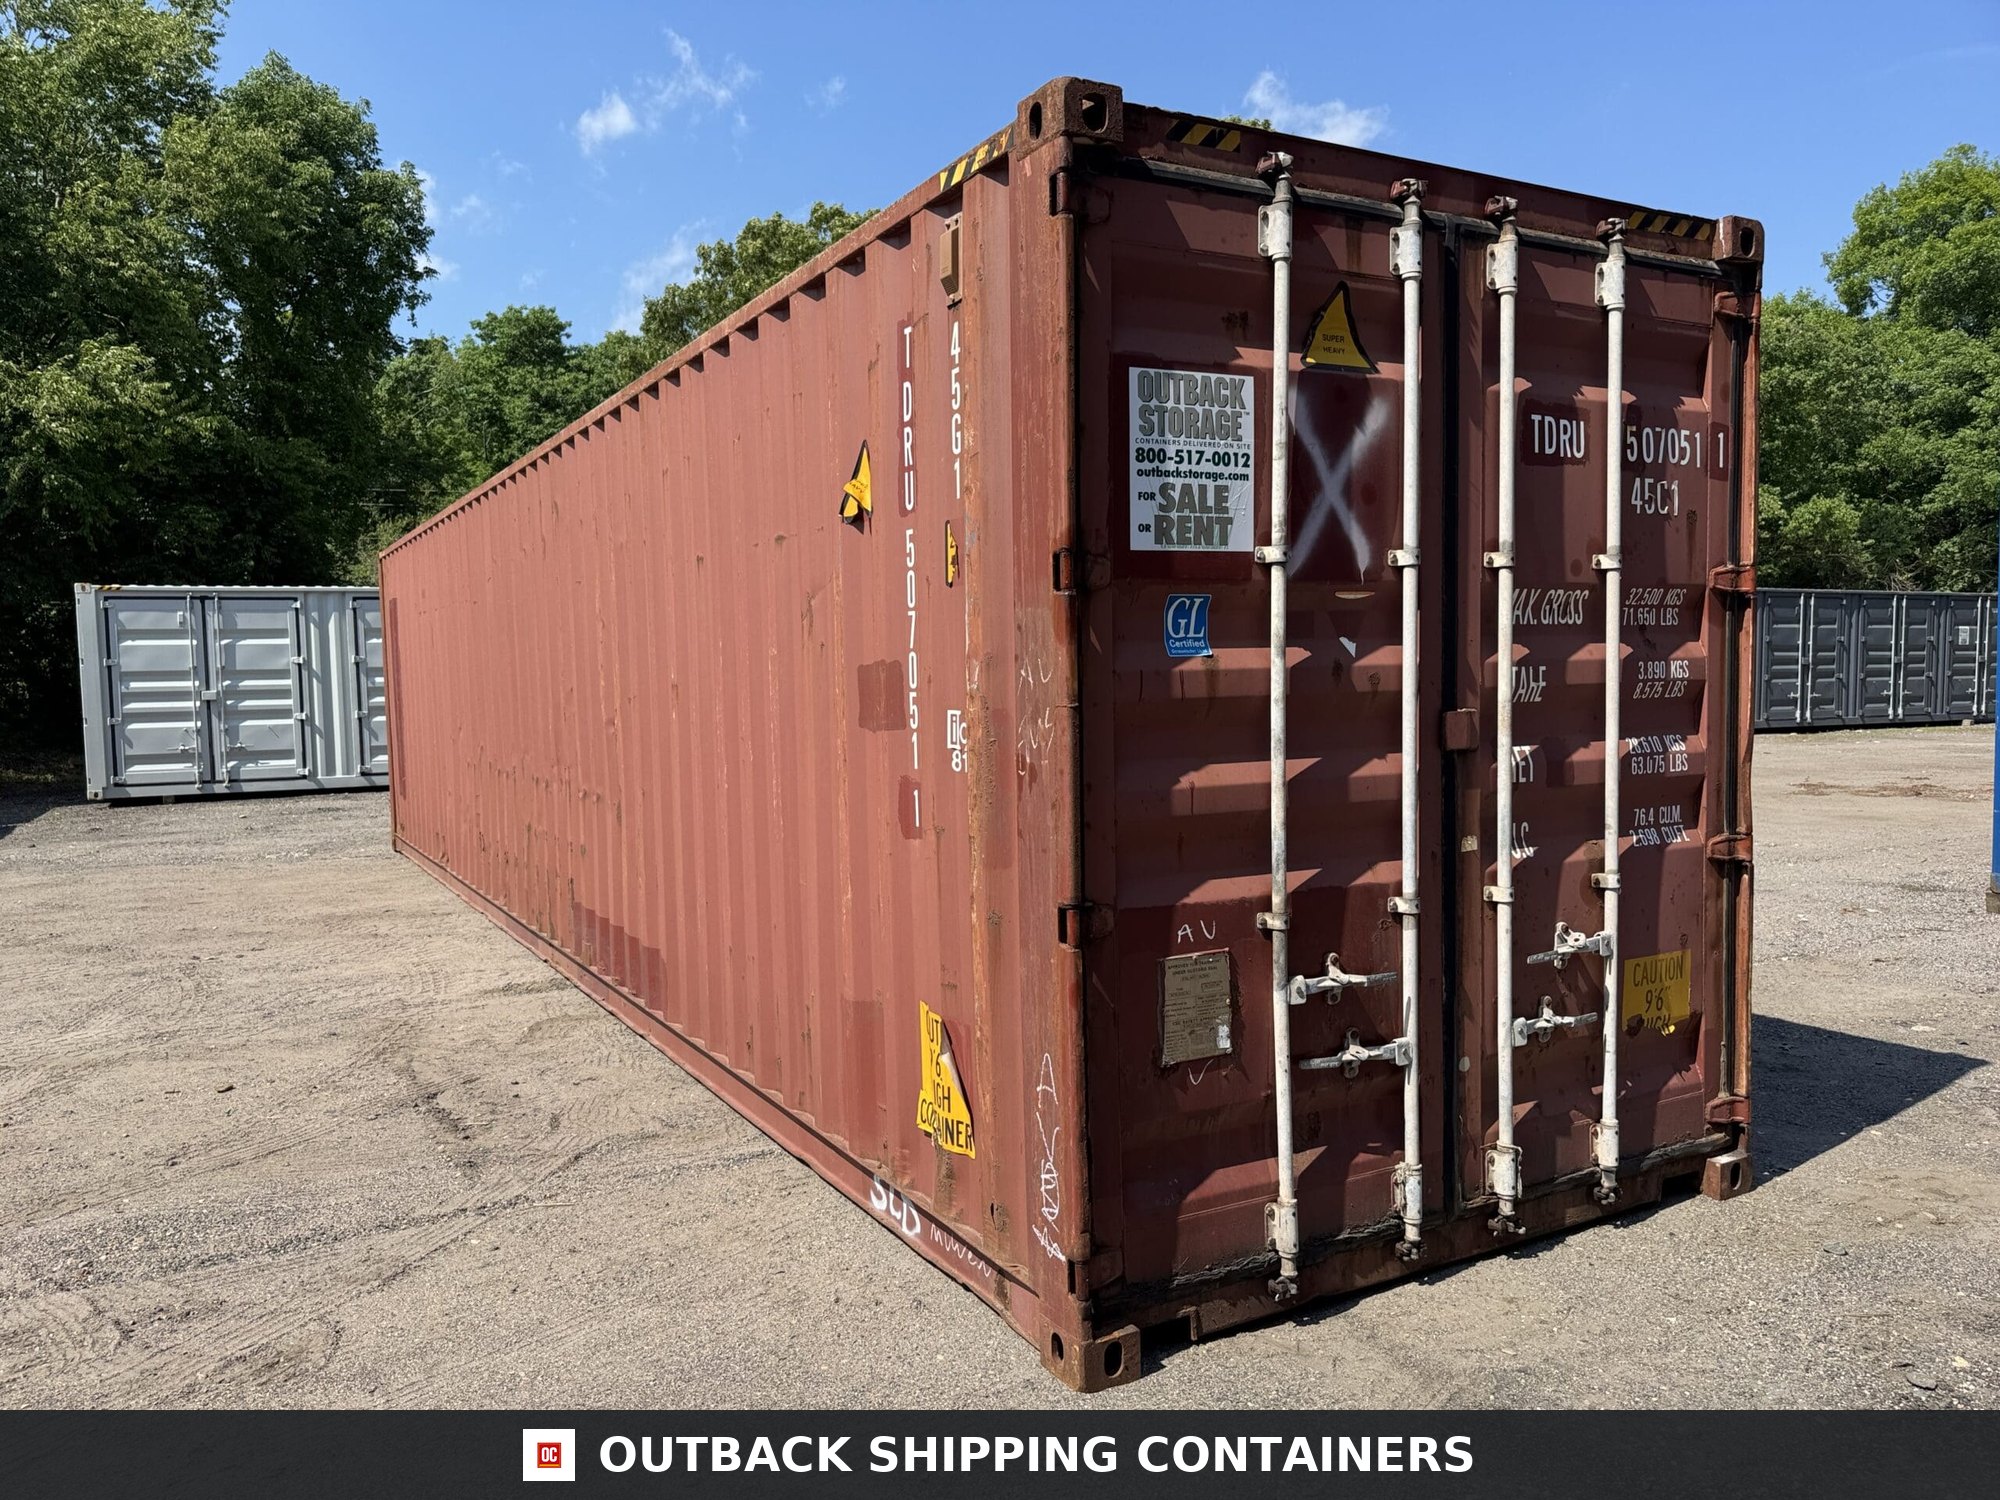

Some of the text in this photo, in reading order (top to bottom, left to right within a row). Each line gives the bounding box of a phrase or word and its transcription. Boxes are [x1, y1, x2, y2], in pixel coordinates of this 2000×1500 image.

[1322, 333, 1345, 343] SUPER
[1322, 345, 1345, 355] HEAVY
[1137, 370, 1246, 410] OUTBACK
[902, 325, 915, 512] TDRU
[950, 320, 961, 500] 45G1
[1138, 403, 1243, 442] STORAGE
[1134, 437, 1181, 447] CONTAINERS
[1183, 440, 1221, 449] DELIVERED
[1223, 442, 1234, 450] ON
[1531, 414, 1585, 459] TDRU
[1135, 446, 1251, 469] 800-517-0012
[1136, 465, 1250, 483] outbackstorage.com
[1137, 481, 1230, 515] FOR SALE
[1137, 514, 1233, 547] OR RENT
[1663, 588, 1687, 606] KGS
[1167, 597, 1206, 639] GL
[1660, 607, 1679, 626] LBS
[905, 528, 919, 770] 507051
[1169, 639, 1206, 648] Certified
[1670, 660, 1690, 679] KGS
[1664, 680, 1688, 698] LBS
[1669, 753, 1688, 772] LBS
[1632, 955, 1684, 987] CAUTION
